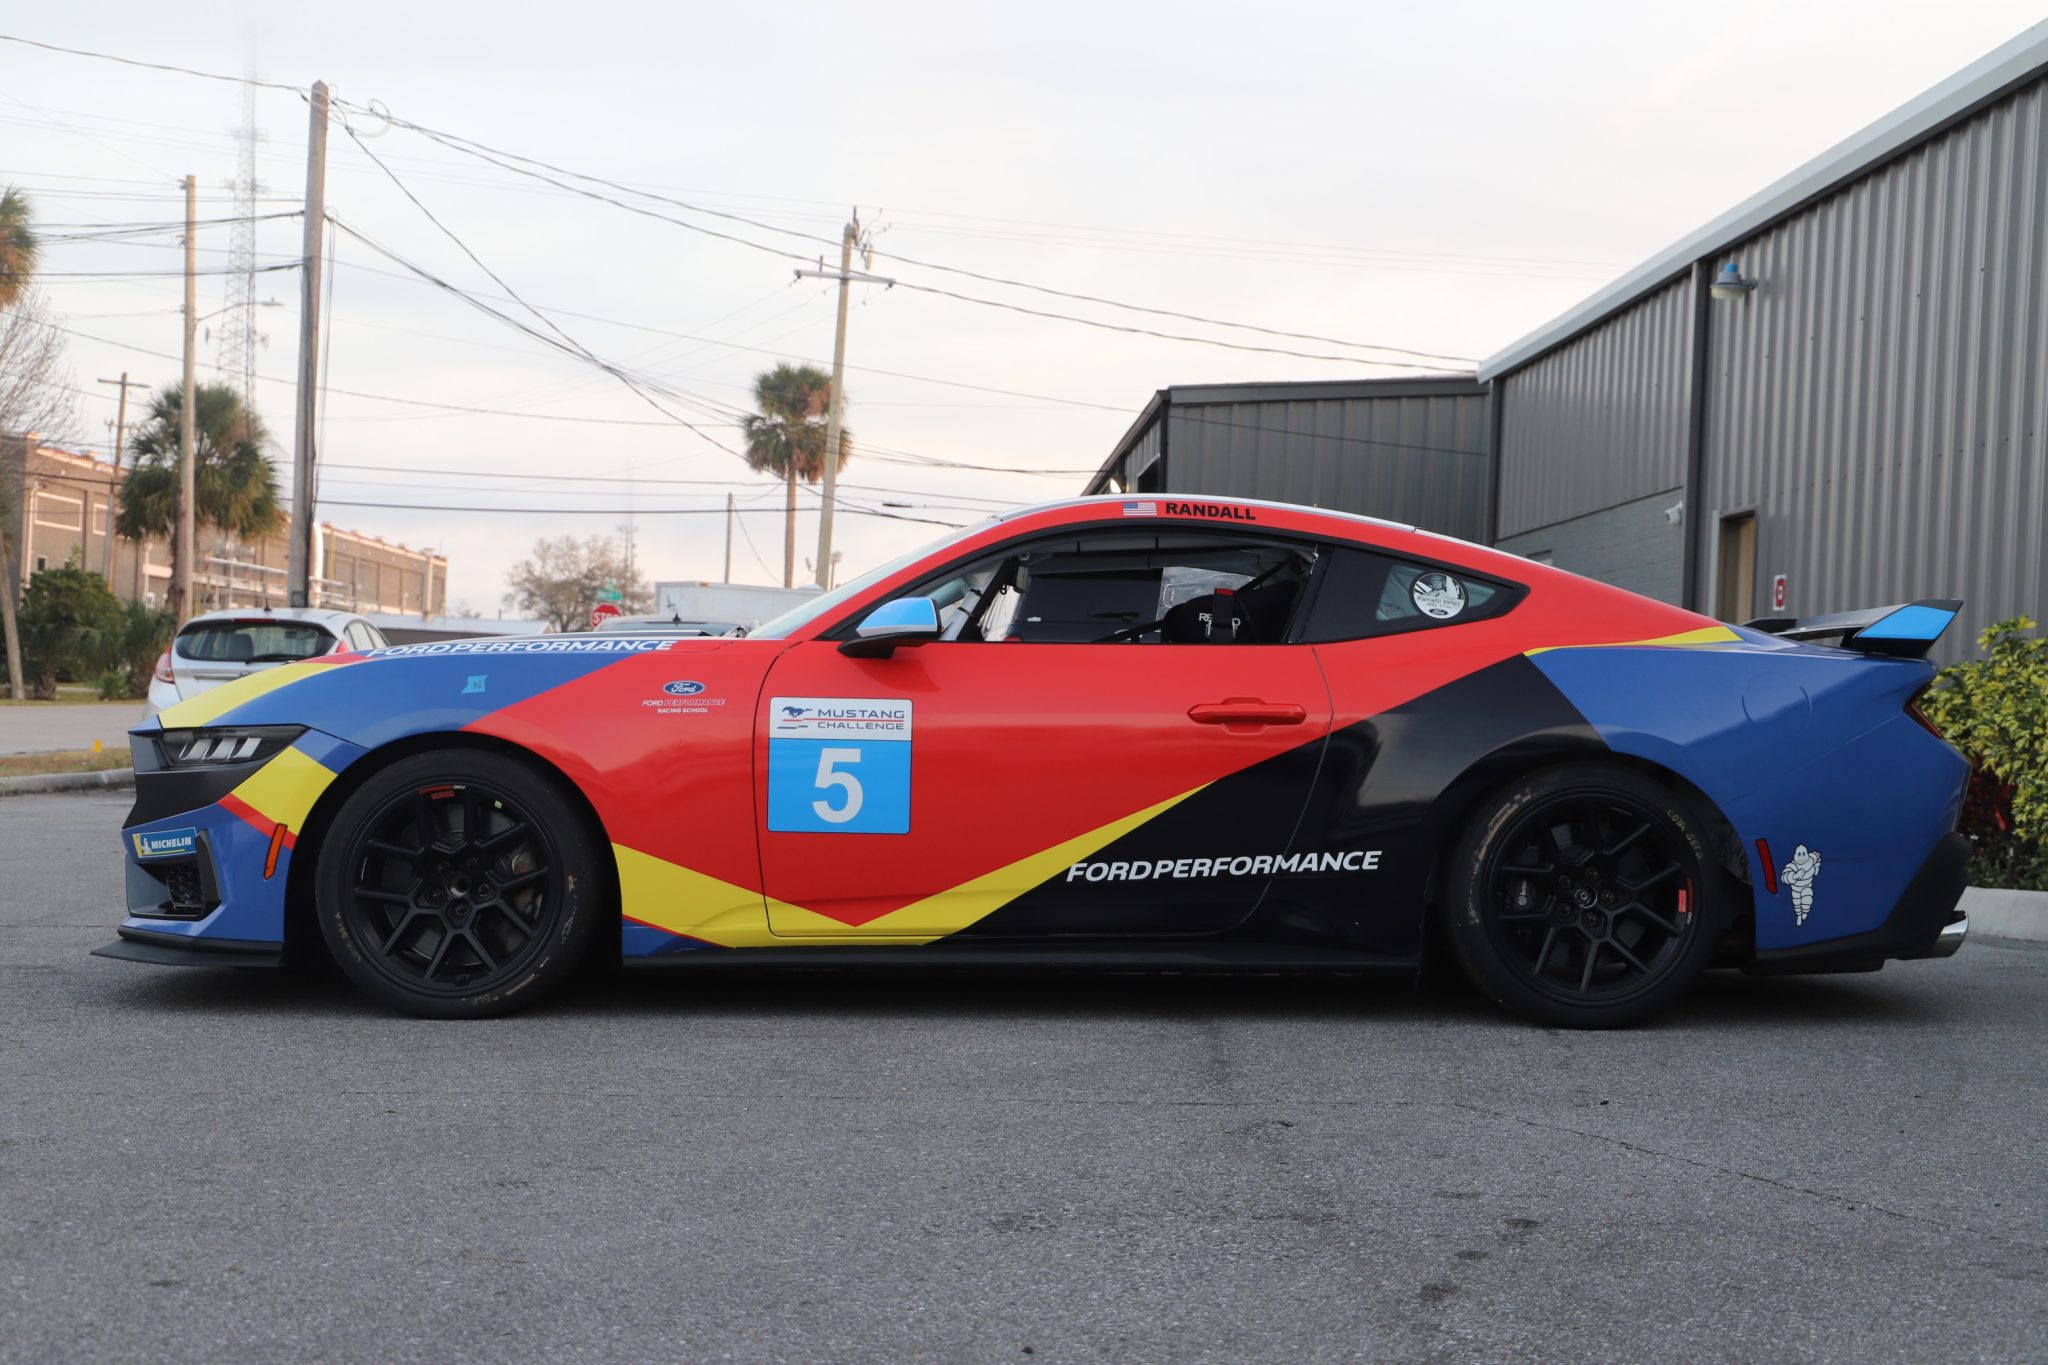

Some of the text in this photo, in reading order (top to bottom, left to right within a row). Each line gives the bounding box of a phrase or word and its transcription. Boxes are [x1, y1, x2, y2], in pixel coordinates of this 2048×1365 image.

[1165, 502, 1256, 520] RANDALL
[1417, 595, 1442, 604] Parnelli
[1443, 599, 1460, 607] Jones
[670, 682, 698, 693] Ford
[818, 709, 905, 719] MUSTANG
[817, 721, 905, 730] CHALLENGE
[812, 747, 864, 823] 5
[151, 836, 192, 850] MICHELIN
